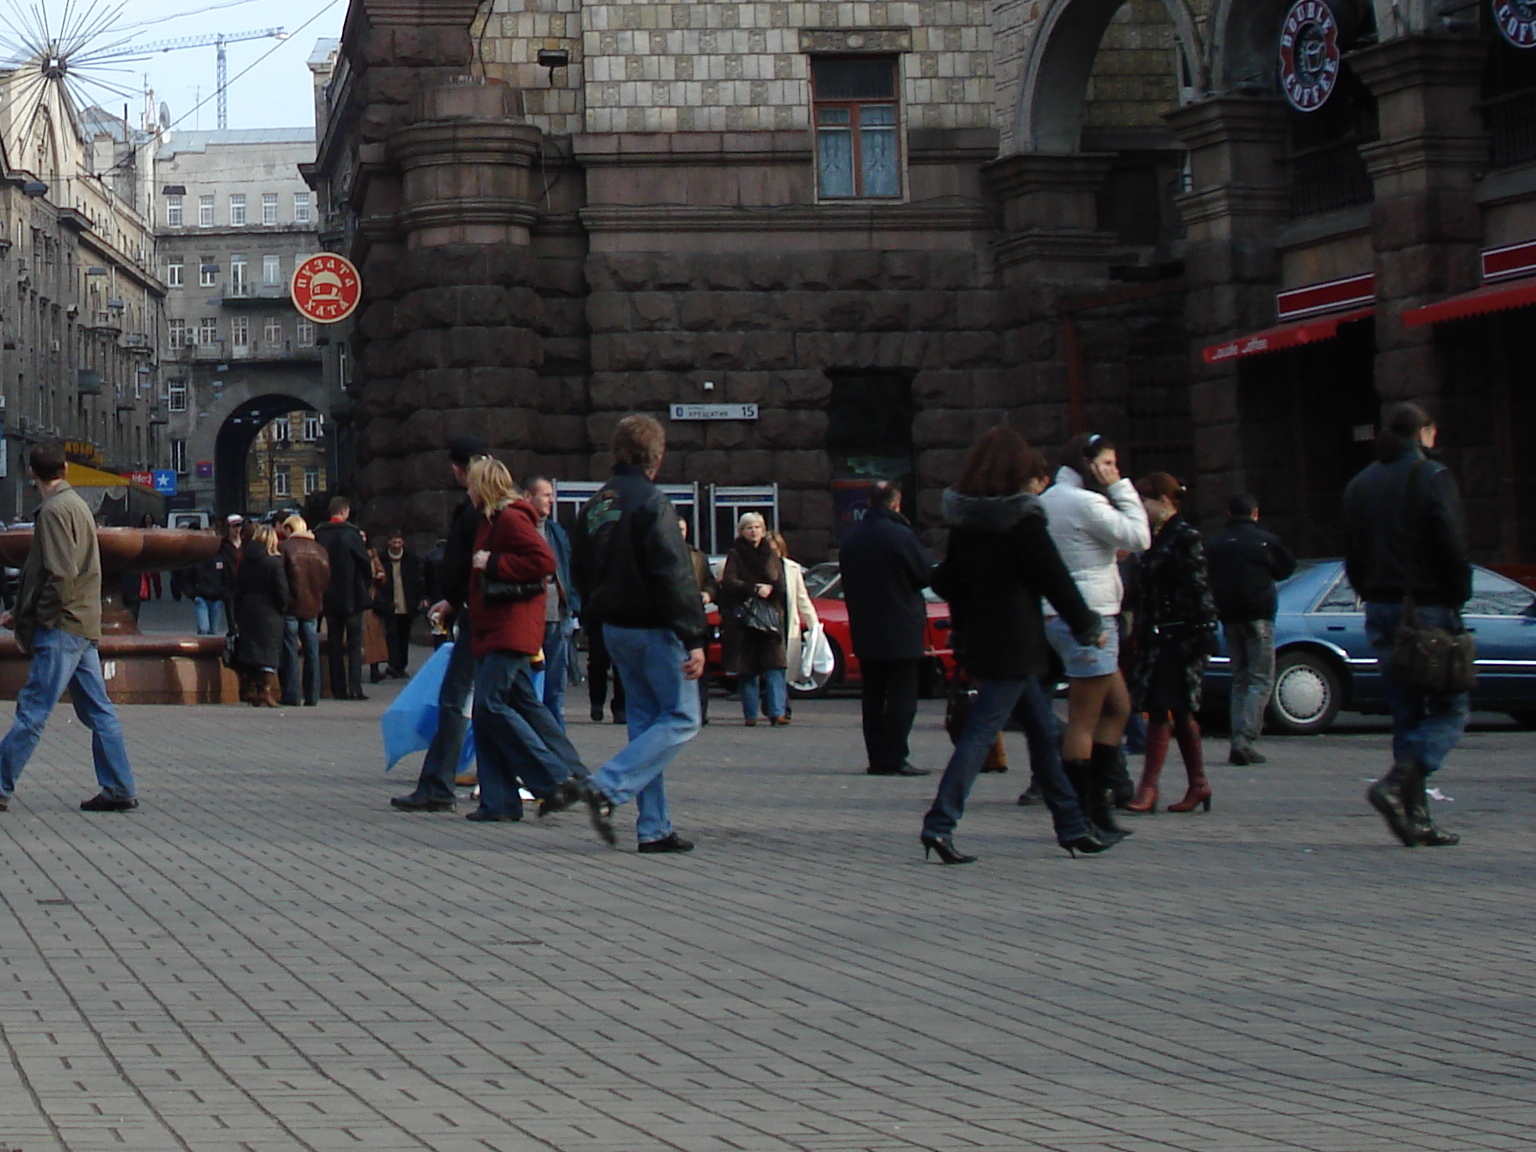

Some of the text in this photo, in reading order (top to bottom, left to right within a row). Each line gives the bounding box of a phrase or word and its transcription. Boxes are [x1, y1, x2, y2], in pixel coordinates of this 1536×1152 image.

[1282, 2, 1333, 47] DOUBLE
[1286, 57, 1336, 106] COFFEE
[297, 259, 355, 287] ПУЗАТА
[304, 299, 350, 316] ХАТА
[742, 406, 755, 417] 15
